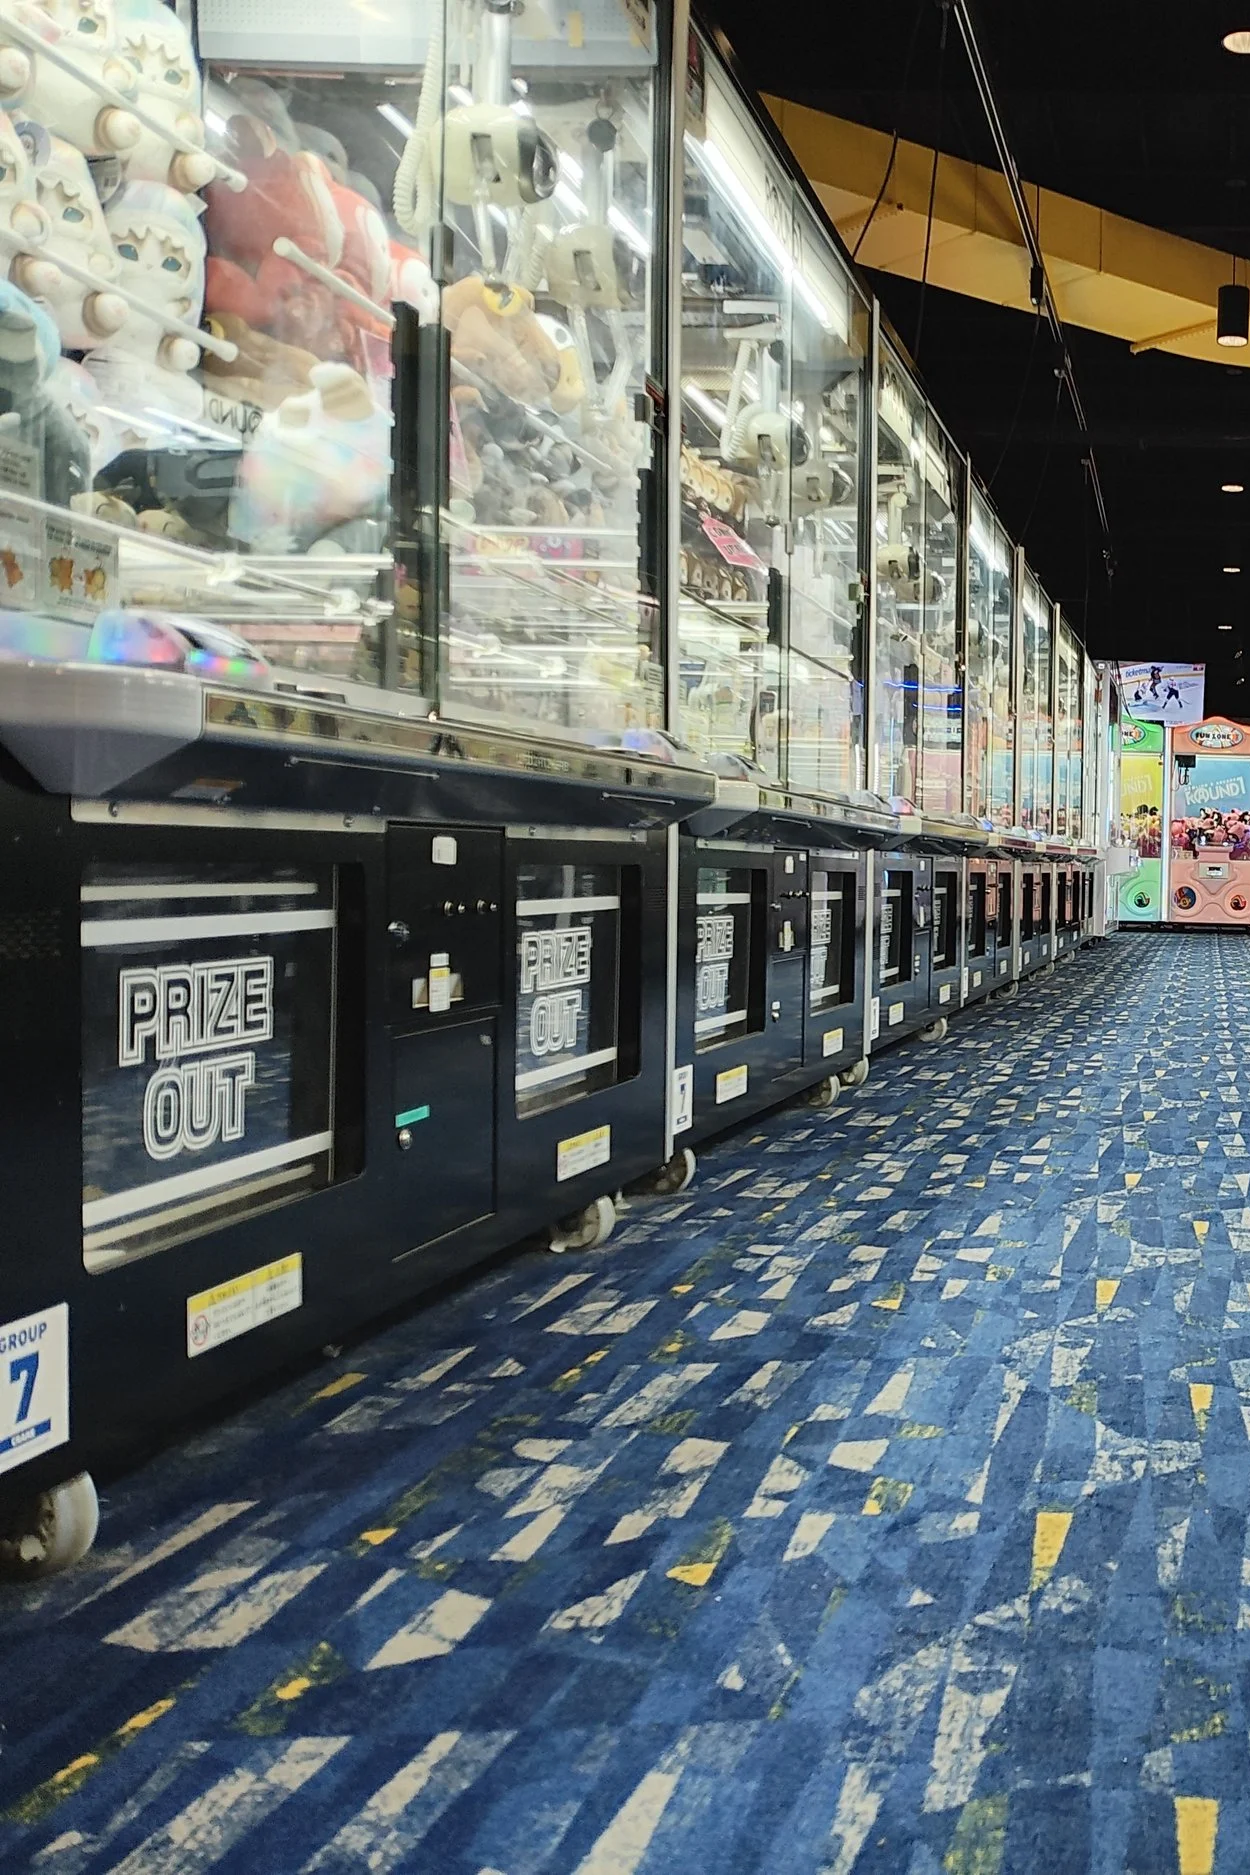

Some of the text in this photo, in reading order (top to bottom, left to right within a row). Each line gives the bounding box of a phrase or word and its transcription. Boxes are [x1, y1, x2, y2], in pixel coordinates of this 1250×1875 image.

[520, 926, 592, 994] PRIZE
[119, 956, 274, 1068] PRIZE
[530, 989, 582, 1056] OUT
[143, 1051, 255, 1160] OUT
[10, 1351, 39, 1424] 7
